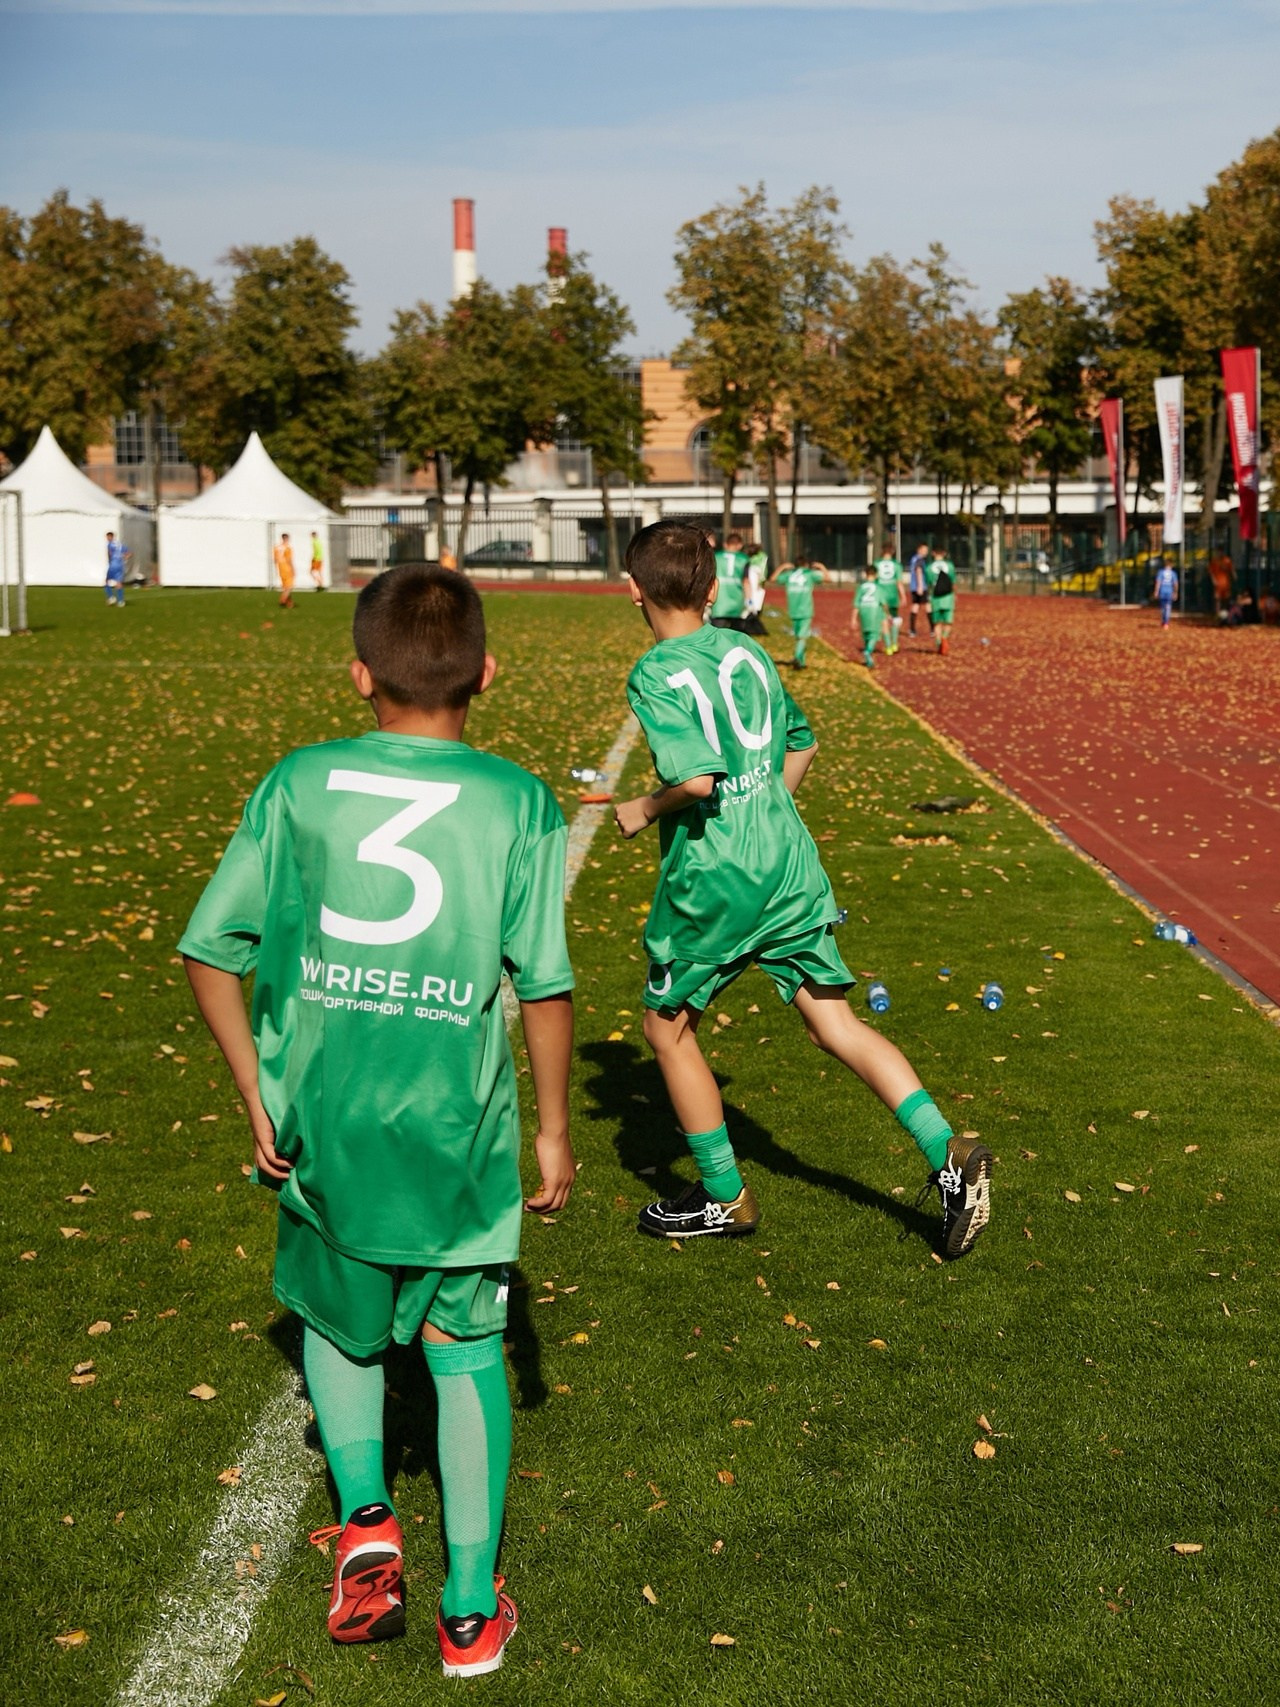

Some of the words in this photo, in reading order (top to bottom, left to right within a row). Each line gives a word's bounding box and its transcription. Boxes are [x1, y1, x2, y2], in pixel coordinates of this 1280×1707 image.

[723, 553, 736, 576] 1
[788, 568, 806, 586] 4
[861, 582, 877, 601] 2
[666, 646, 772, 756] 10
[320, 769, 462, 945] 3
[414, 1006, 470, 1027] ФОРМЫ
